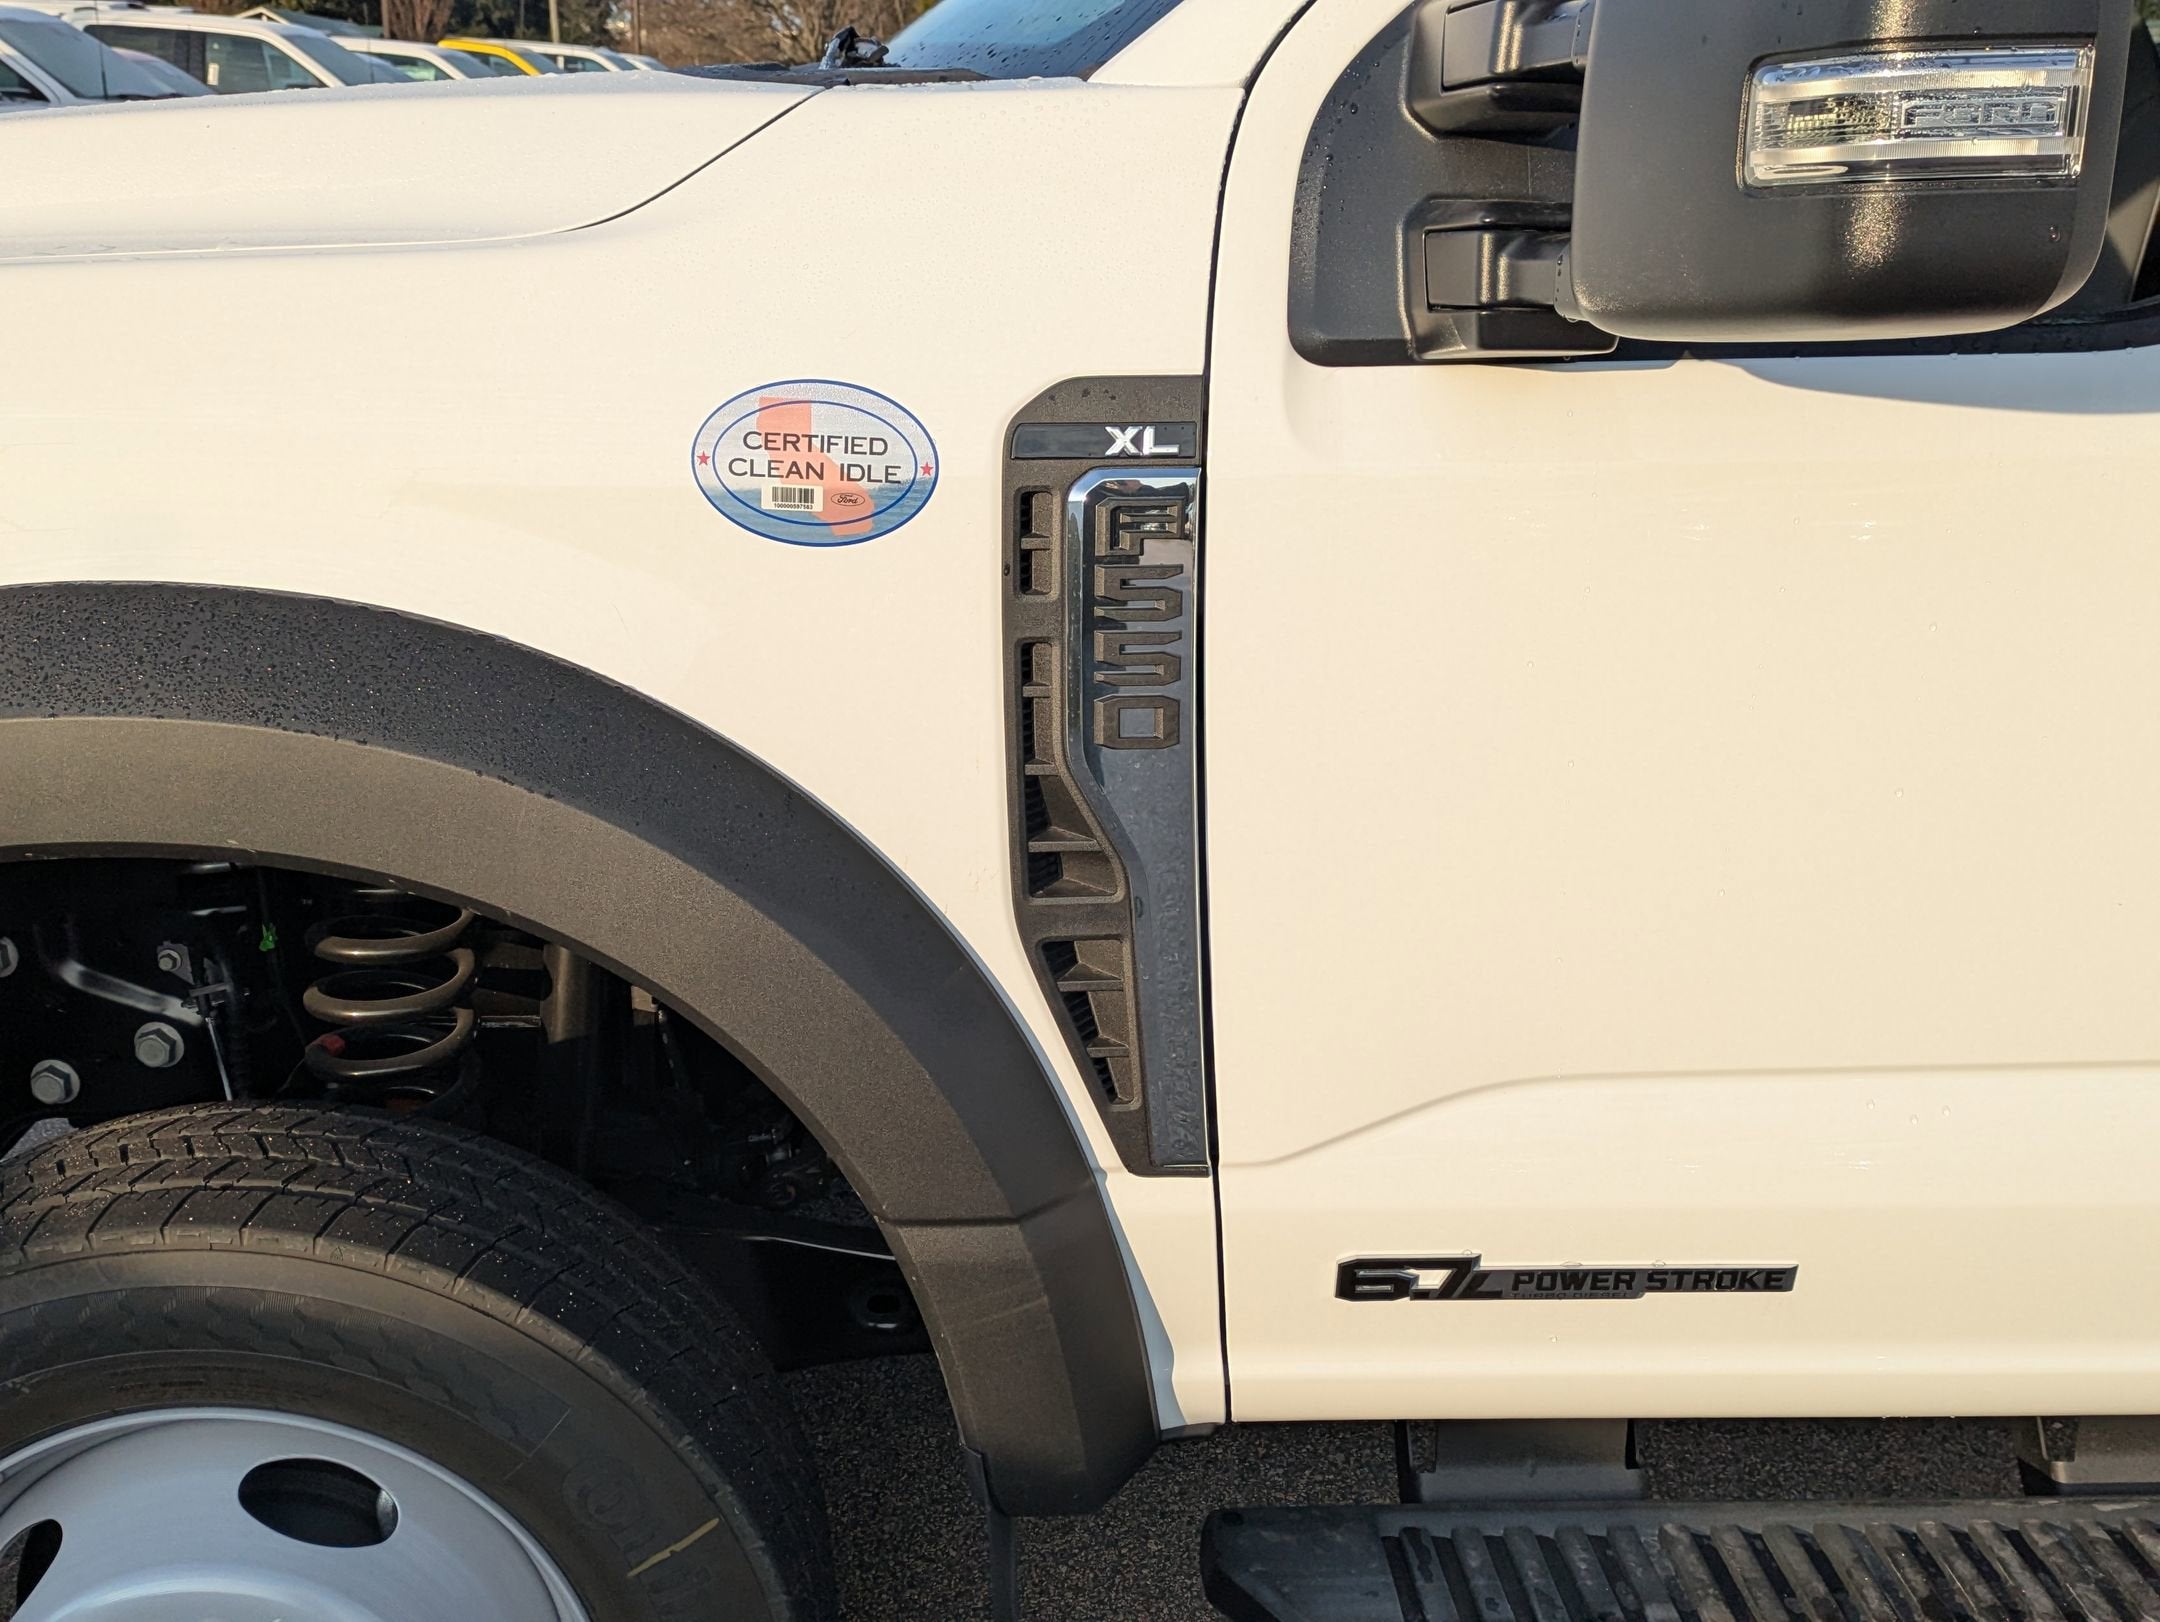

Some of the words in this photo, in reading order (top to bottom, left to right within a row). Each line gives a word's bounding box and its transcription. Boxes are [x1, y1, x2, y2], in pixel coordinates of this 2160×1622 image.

[742, 430, 889, 456] CERTIFIED
[1104, 425, 1180, 457] XL
[728, 457, 825, 481] CLEAN
[839, 463, 902, 485] IDLE
[837, 494, 859, 504] Ford
[1335, 1253, 1504, 1301] 6.7L
[1511, 1269, 1637, 1292] POWER
[1645, 1268, 1789, 1292] STROKE
